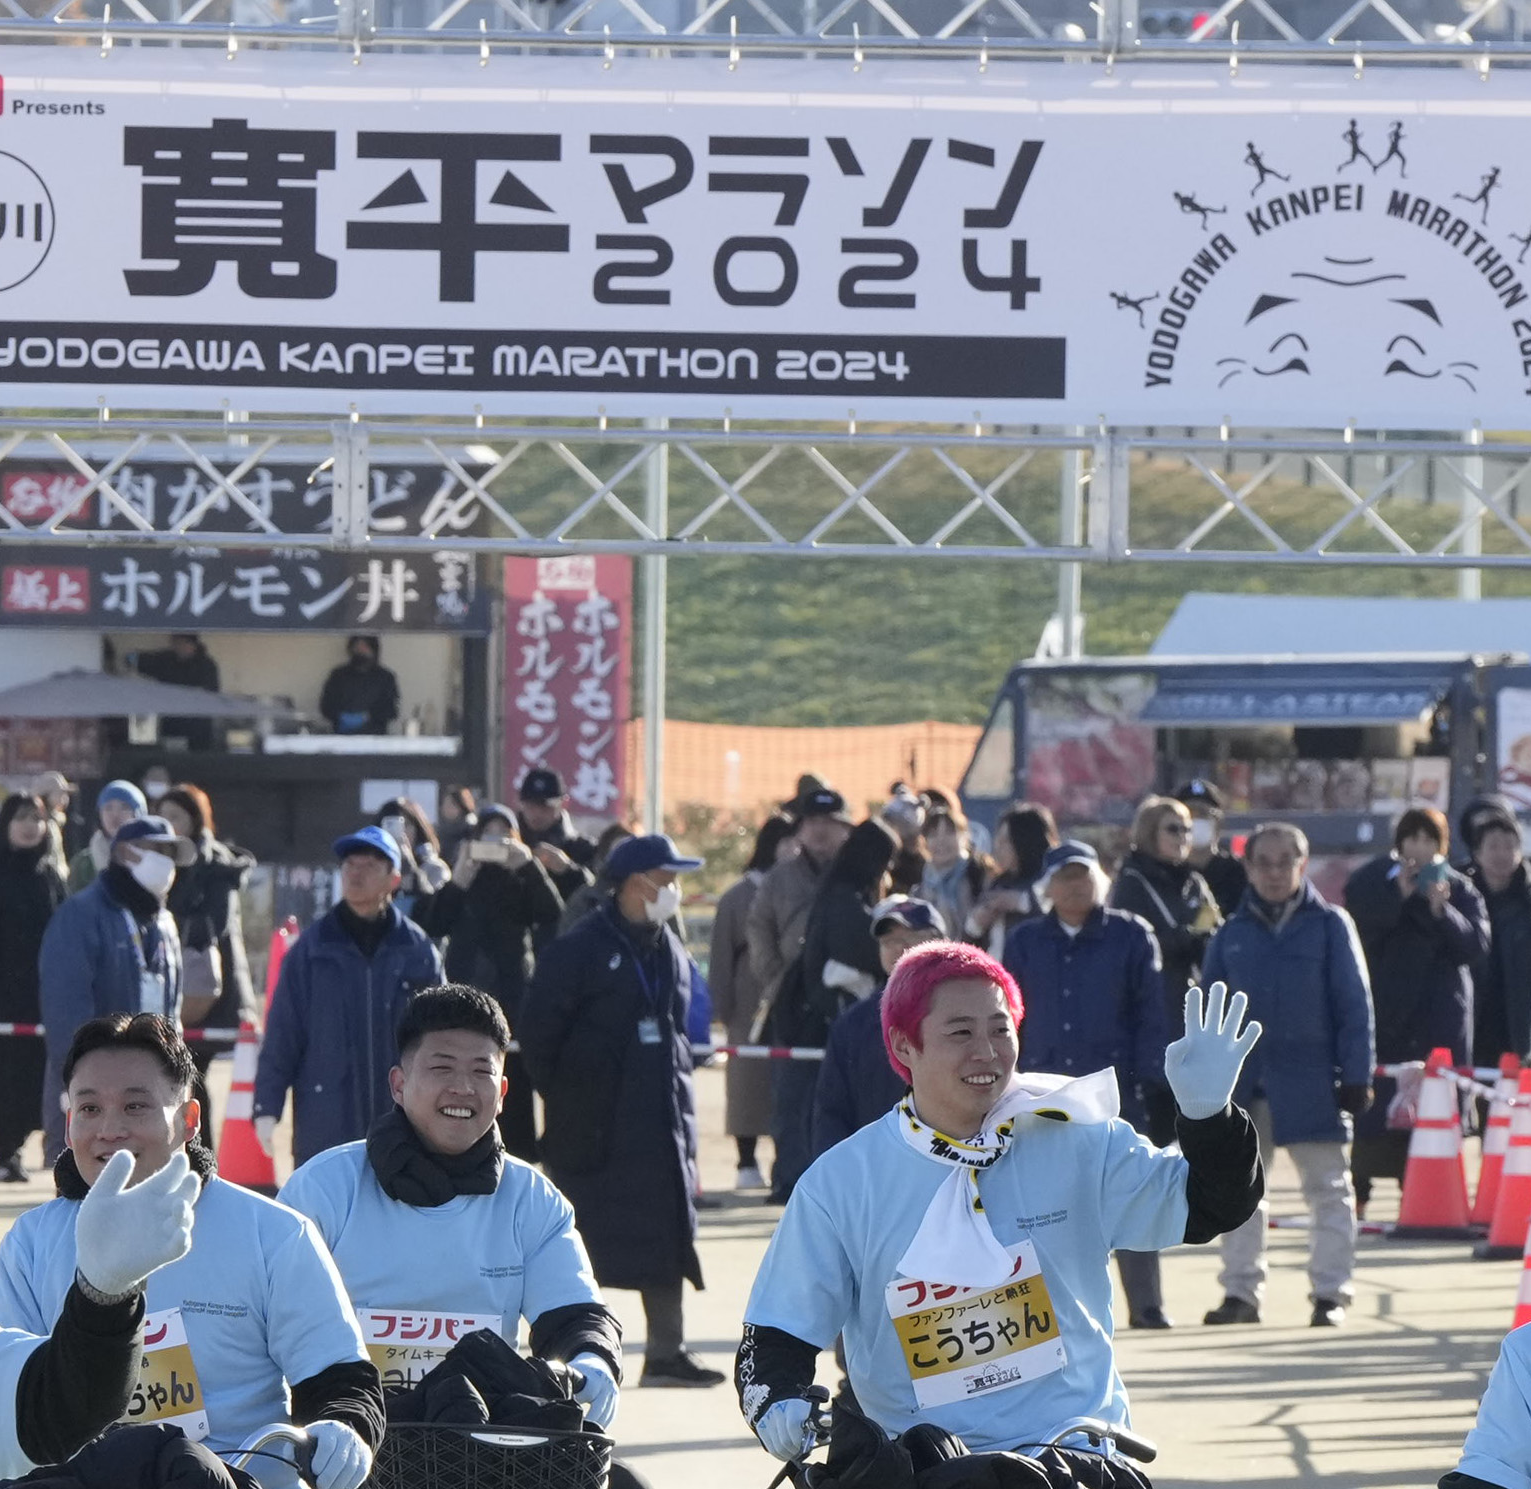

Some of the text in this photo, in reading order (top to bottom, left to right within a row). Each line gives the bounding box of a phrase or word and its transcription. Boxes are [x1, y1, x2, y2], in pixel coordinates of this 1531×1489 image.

[12, 98, 106, 121] Presents
[123, 117, 1048, 303] 寛平 マラソン
[589, 234, 1044, 312] 2024
[1144, 232, 1239, 390] YODOGAWA
[1245, 183, 1365, 237] KANPEI
[1386, 188, 1530, 311] MARATHON
[278, 338, 475, 377] KANPEI
[490, 342, 761, 381] MARATHON
[774, 348, 912, 384] 2024
[101, 556, 419, 624] ホルモン丼
[513, 588, 565, 790] ホルモン
[570, 586, 621, 812] ホルモン丼
[907, 1301, 1051, 1369] こうちゃん
[908, 1281, 1032, 1329] ファンファーレと熱狂
